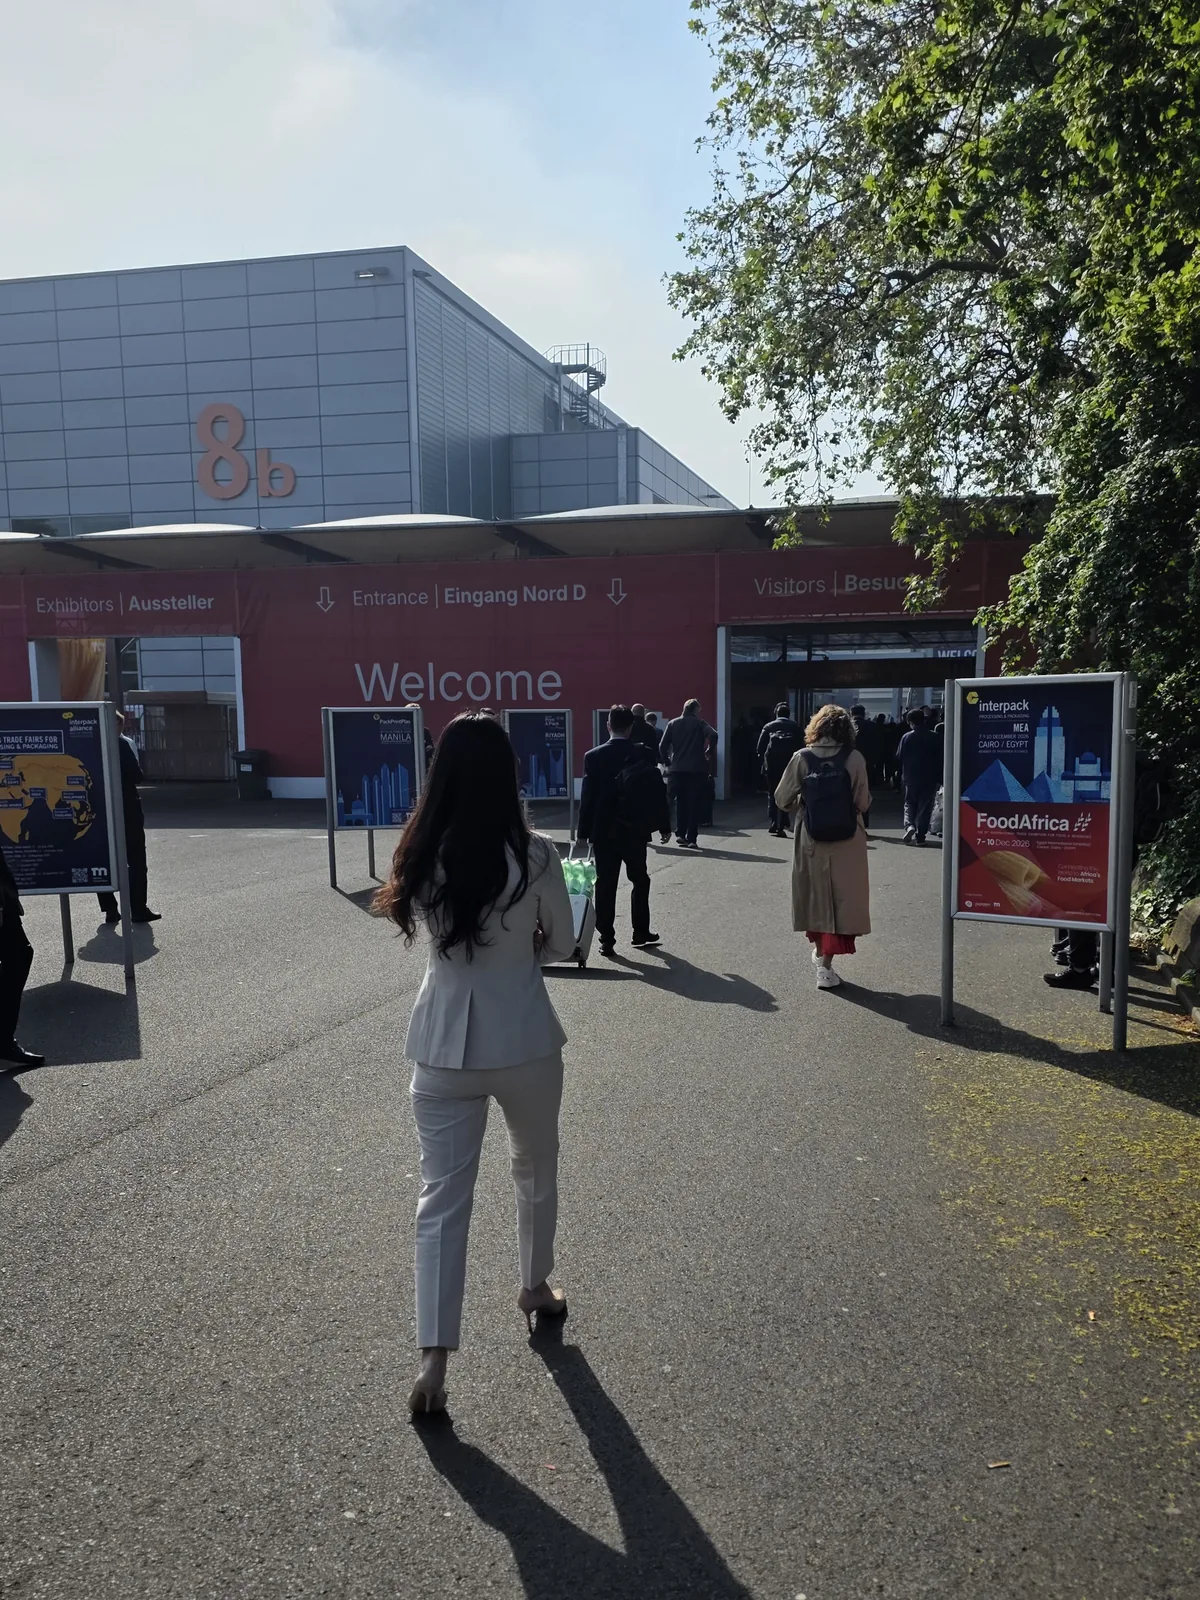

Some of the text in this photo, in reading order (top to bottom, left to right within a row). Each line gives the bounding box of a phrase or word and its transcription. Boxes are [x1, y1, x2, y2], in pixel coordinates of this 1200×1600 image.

[753, 577, 826, 596] Visitors
[353, 583, 587, 608] Entrance Eingang Nord D
[36, 594, 215, 613] Exhibitors Aussteller
[354, 661, 563, 702] Welcome
[979, 698, 1030, 714] interpack
[69, 718, 97, 726] interpack
[1013, 723, 1029, 732] MEA
[3, 735, 58, 744] TRADE FAIRS FOR
[380, 733, 412, 741] MANILA
[978, 740, 1000, 749] CAIRO
[1006, 740, 1029, 748] EGYPT
[976, 812, 1069, 831] FoodAfrica
[995, 838, 1010, 847] Dec
[1011, 839, 1031, 848] 2026
[1071, 876, 1094, 884] Markets
